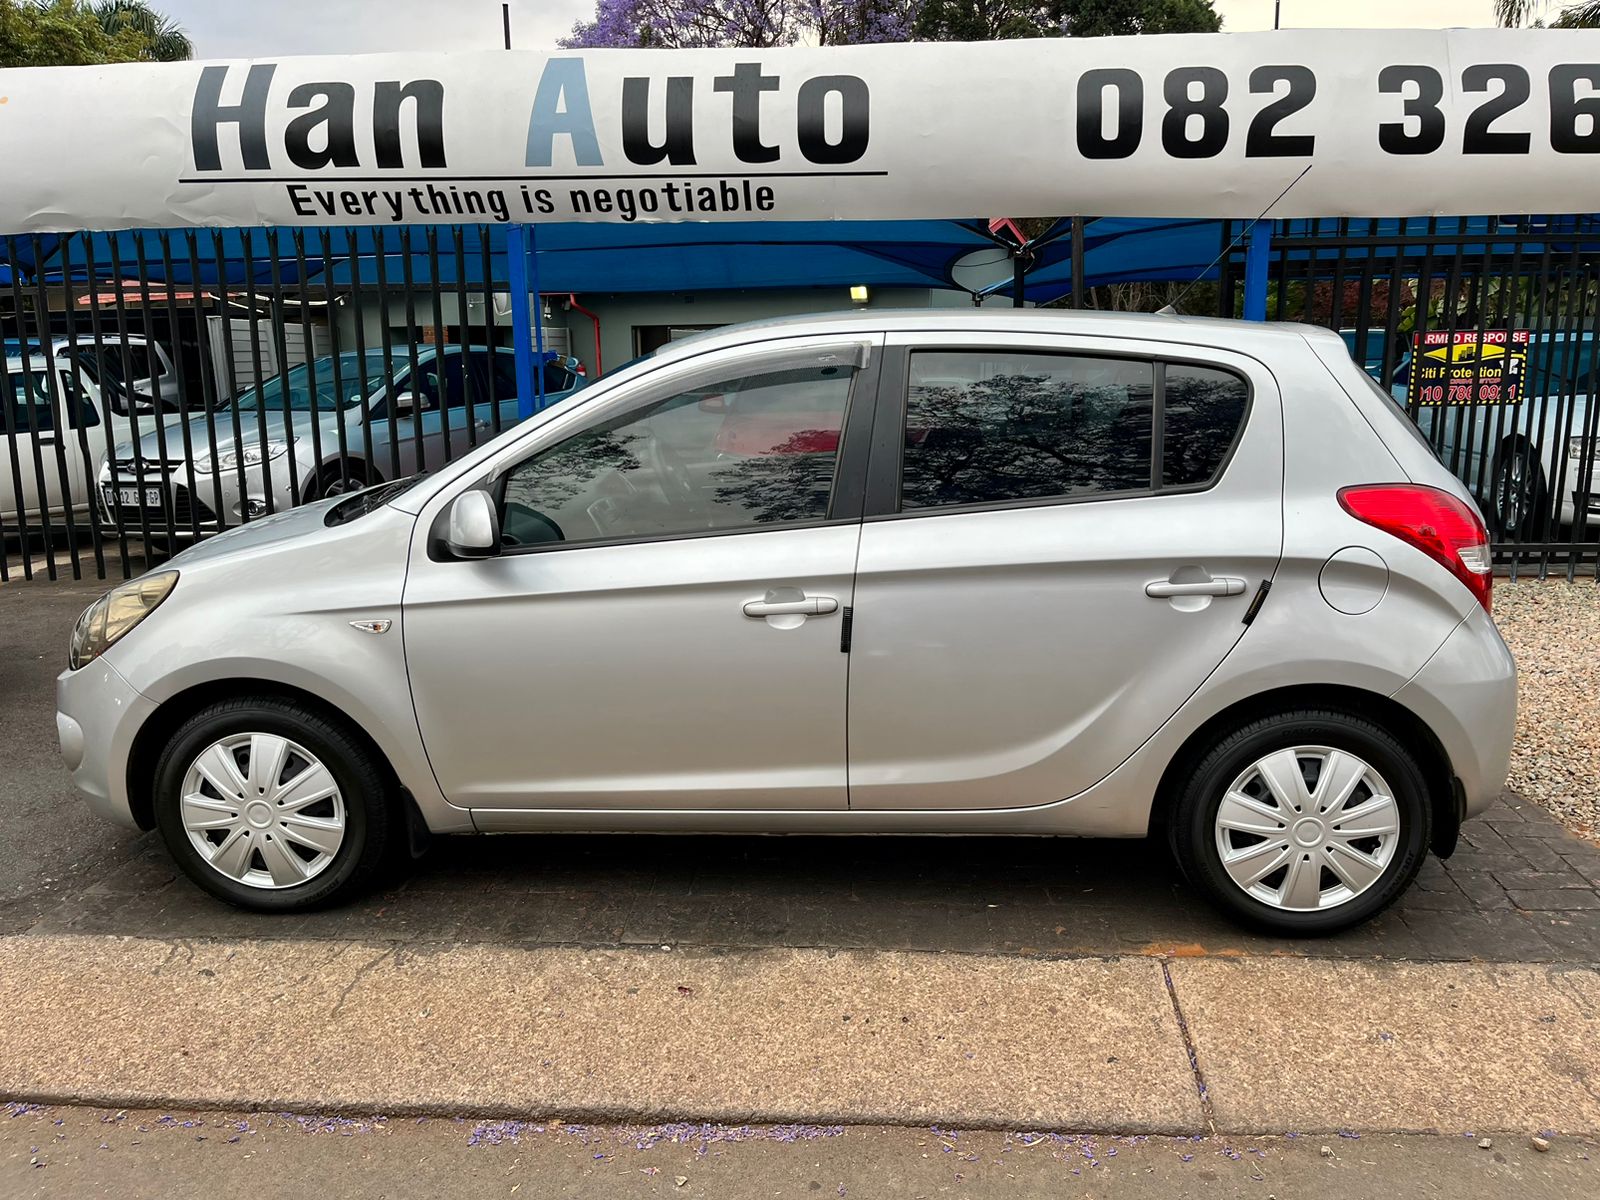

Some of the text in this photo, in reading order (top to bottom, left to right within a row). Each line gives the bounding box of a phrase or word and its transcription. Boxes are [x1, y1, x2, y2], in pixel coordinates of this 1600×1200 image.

[191, 57, 870, 171] Han Auto
[1077, 63, 1600, 159] 082 326
[286, 180, 775, 222] Everything is negotiable
[1440, 366, 1502, 379] Potetion
